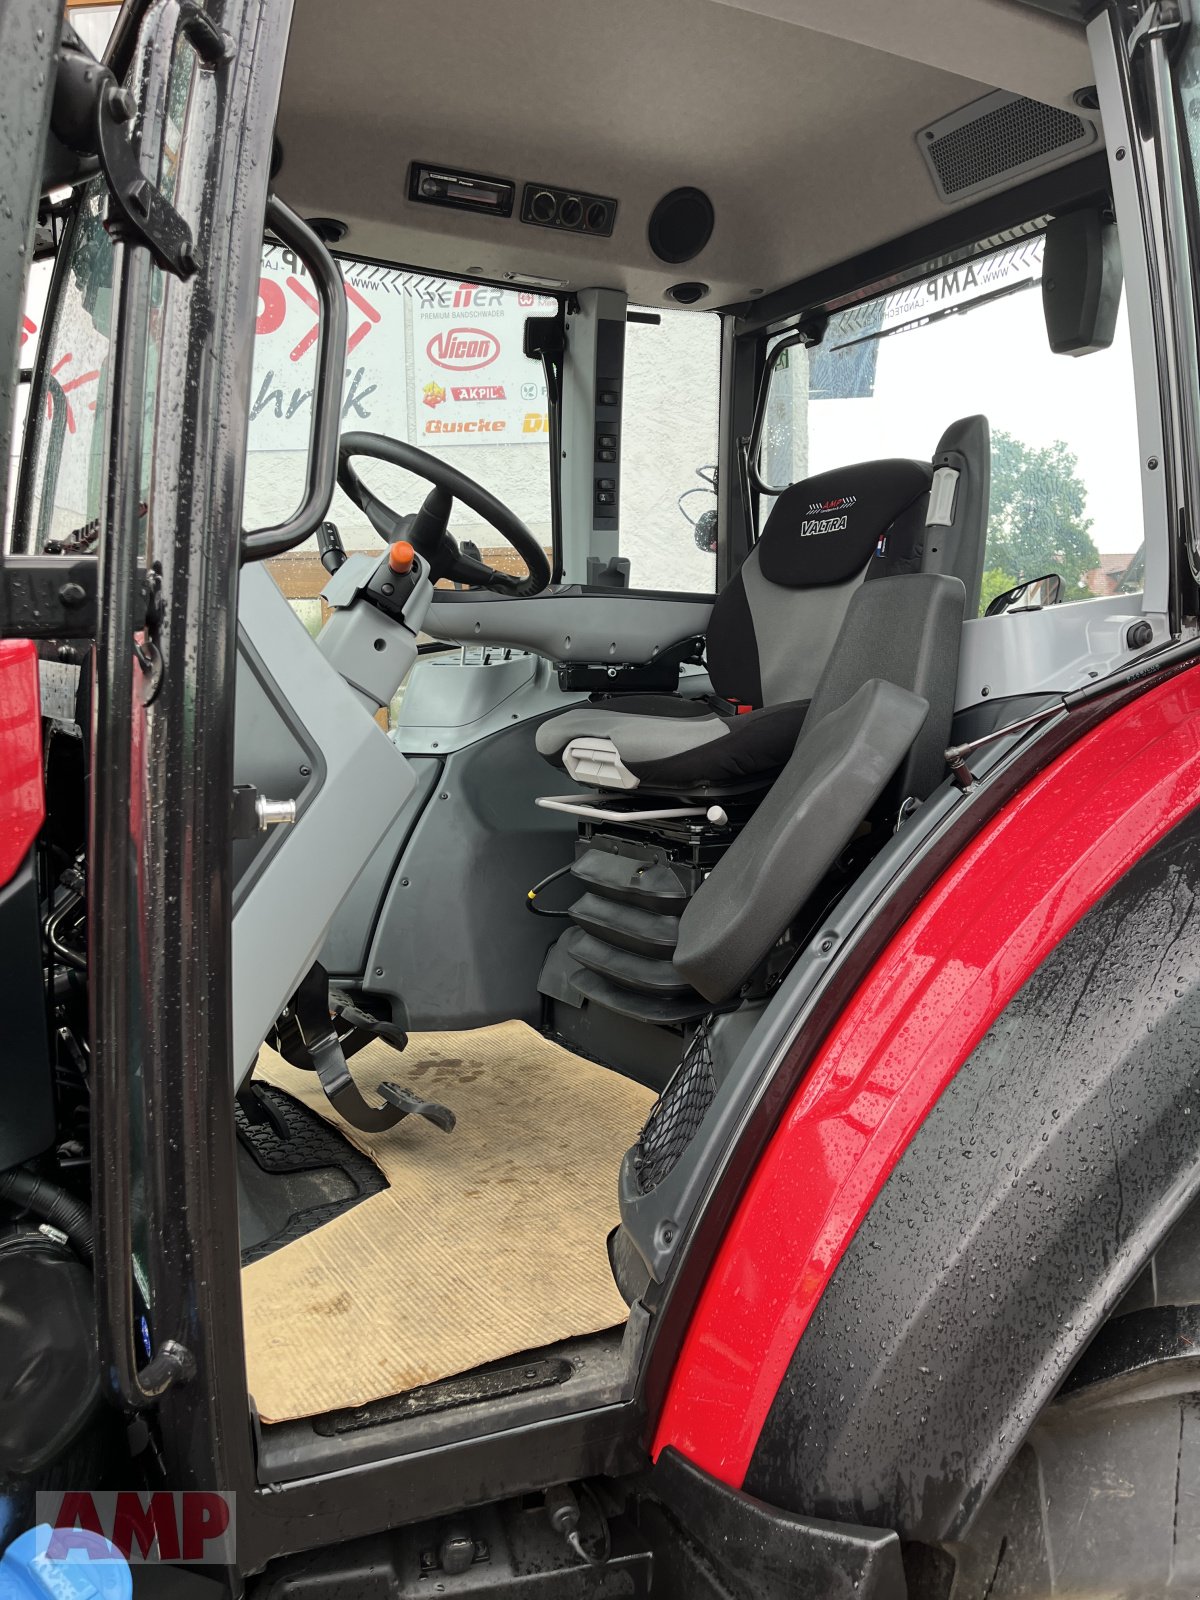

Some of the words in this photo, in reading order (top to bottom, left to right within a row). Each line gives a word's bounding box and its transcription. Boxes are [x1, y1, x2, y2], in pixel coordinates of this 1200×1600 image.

[420, 311, 451, 320] PREMIUM
[436, 329, 492, 360] Vicon
[458, 387, 498, 400] AKPIL
[425, 418, 507, 434] Quicke
[800, 515, 848, 537] VALTRA
